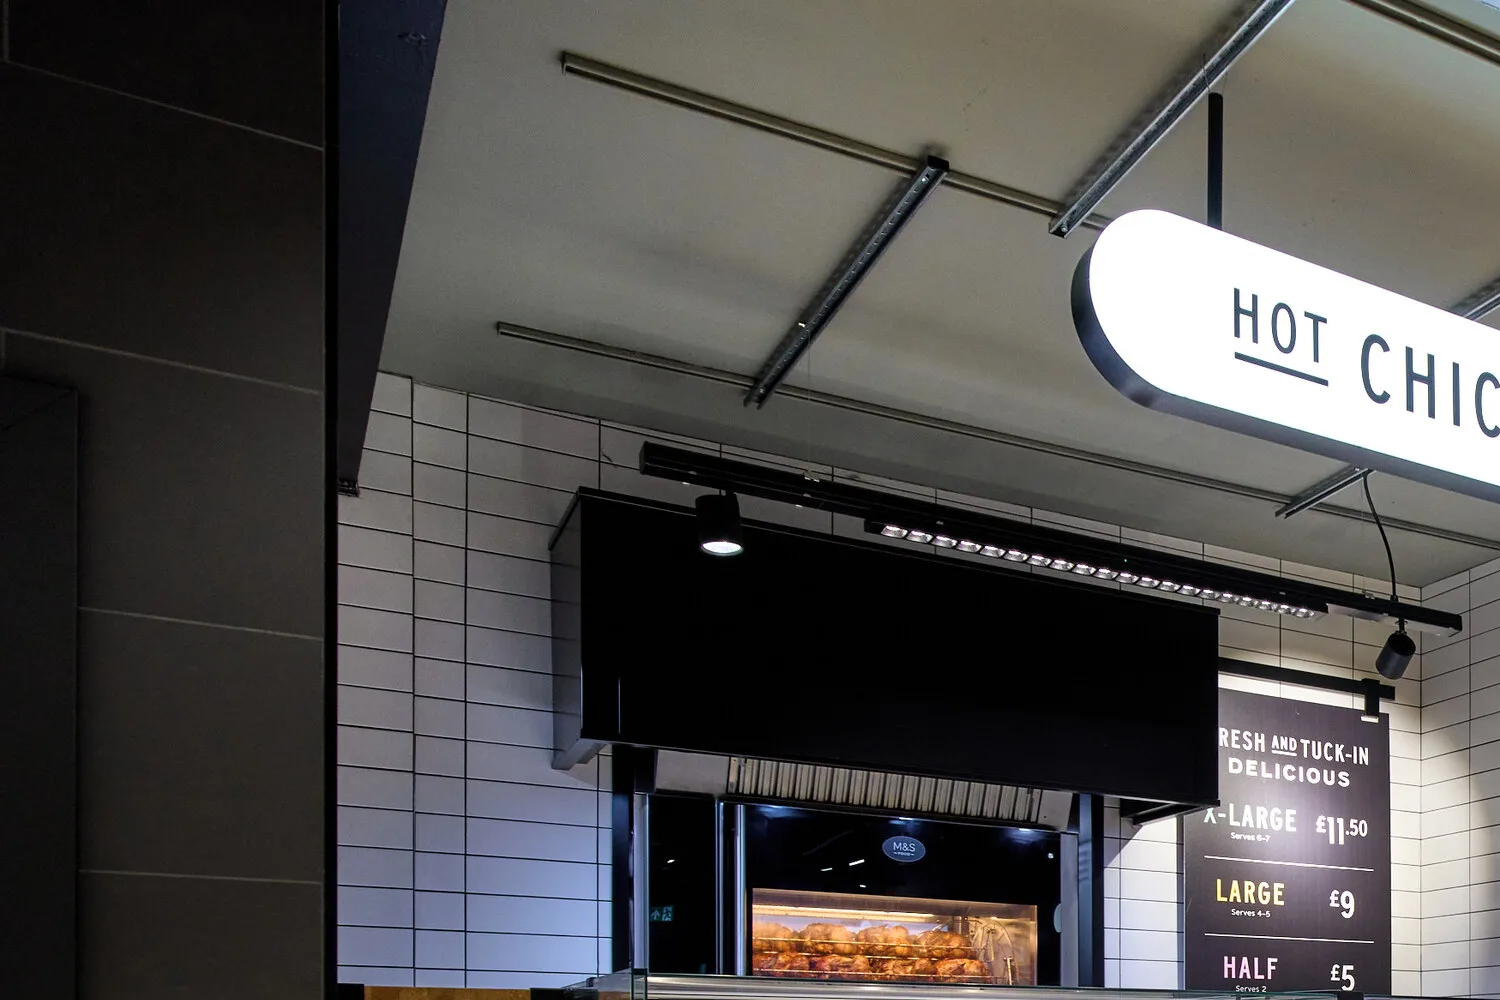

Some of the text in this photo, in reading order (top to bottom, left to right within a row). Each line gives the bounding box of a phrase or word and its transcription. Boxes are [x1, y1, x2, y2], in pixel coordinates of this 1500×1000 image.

[1233, 288, 1328, 362] HOT
[1218, 727, 1369, 766] RESH AND TUCK-IN
[1229, 757, 1350, 788] DELICIOUS
[893, 841, 916, 852] M&S
[1230, 831, 1254, 841] Serves
[1216, 878, 1355, 919] LARGE £9
[1231, 908, 1255, 917] Serves
[1223, 956, 1355, 992] HALF £5
[1235, 984, 1267, 993] Serves 2
